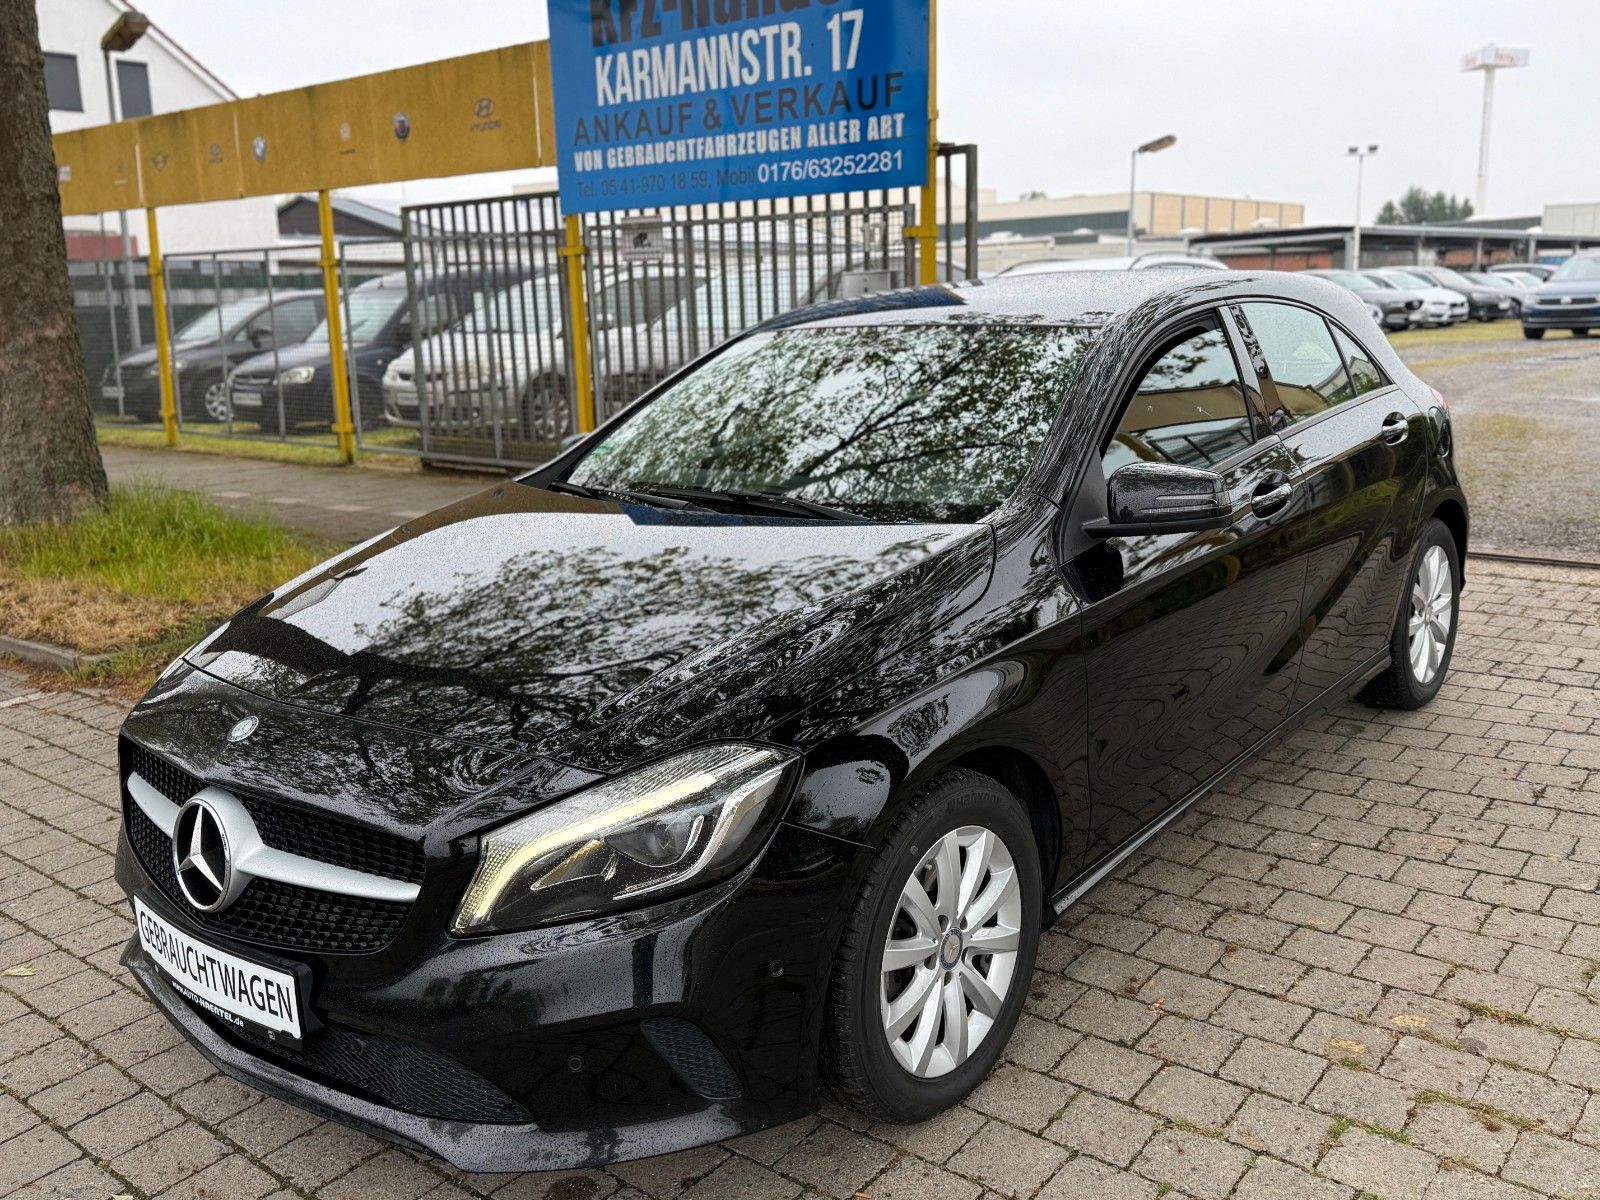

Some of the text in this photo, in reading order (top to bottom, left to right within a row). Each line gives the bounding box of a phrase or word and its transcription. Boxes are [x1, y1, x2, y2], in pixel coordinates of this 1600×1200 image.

[594, 8, 864, 107] KARMANNSTR. 17
[573, 71, 905, 147] ANKAUF & VERKAUF
[573, 112, 906, 173] VON GEBRAUCHTFAHRZEUGEN ALLER ART
[601, 179, 617, 197] 05
[620, 174, 665, 194] 41-970
[671, 172, 686, 191] 18
[757, 149, 903, 184] 0176/63252281
[139, 910, 294, 1023] GEBRAUCHTWAGEN
